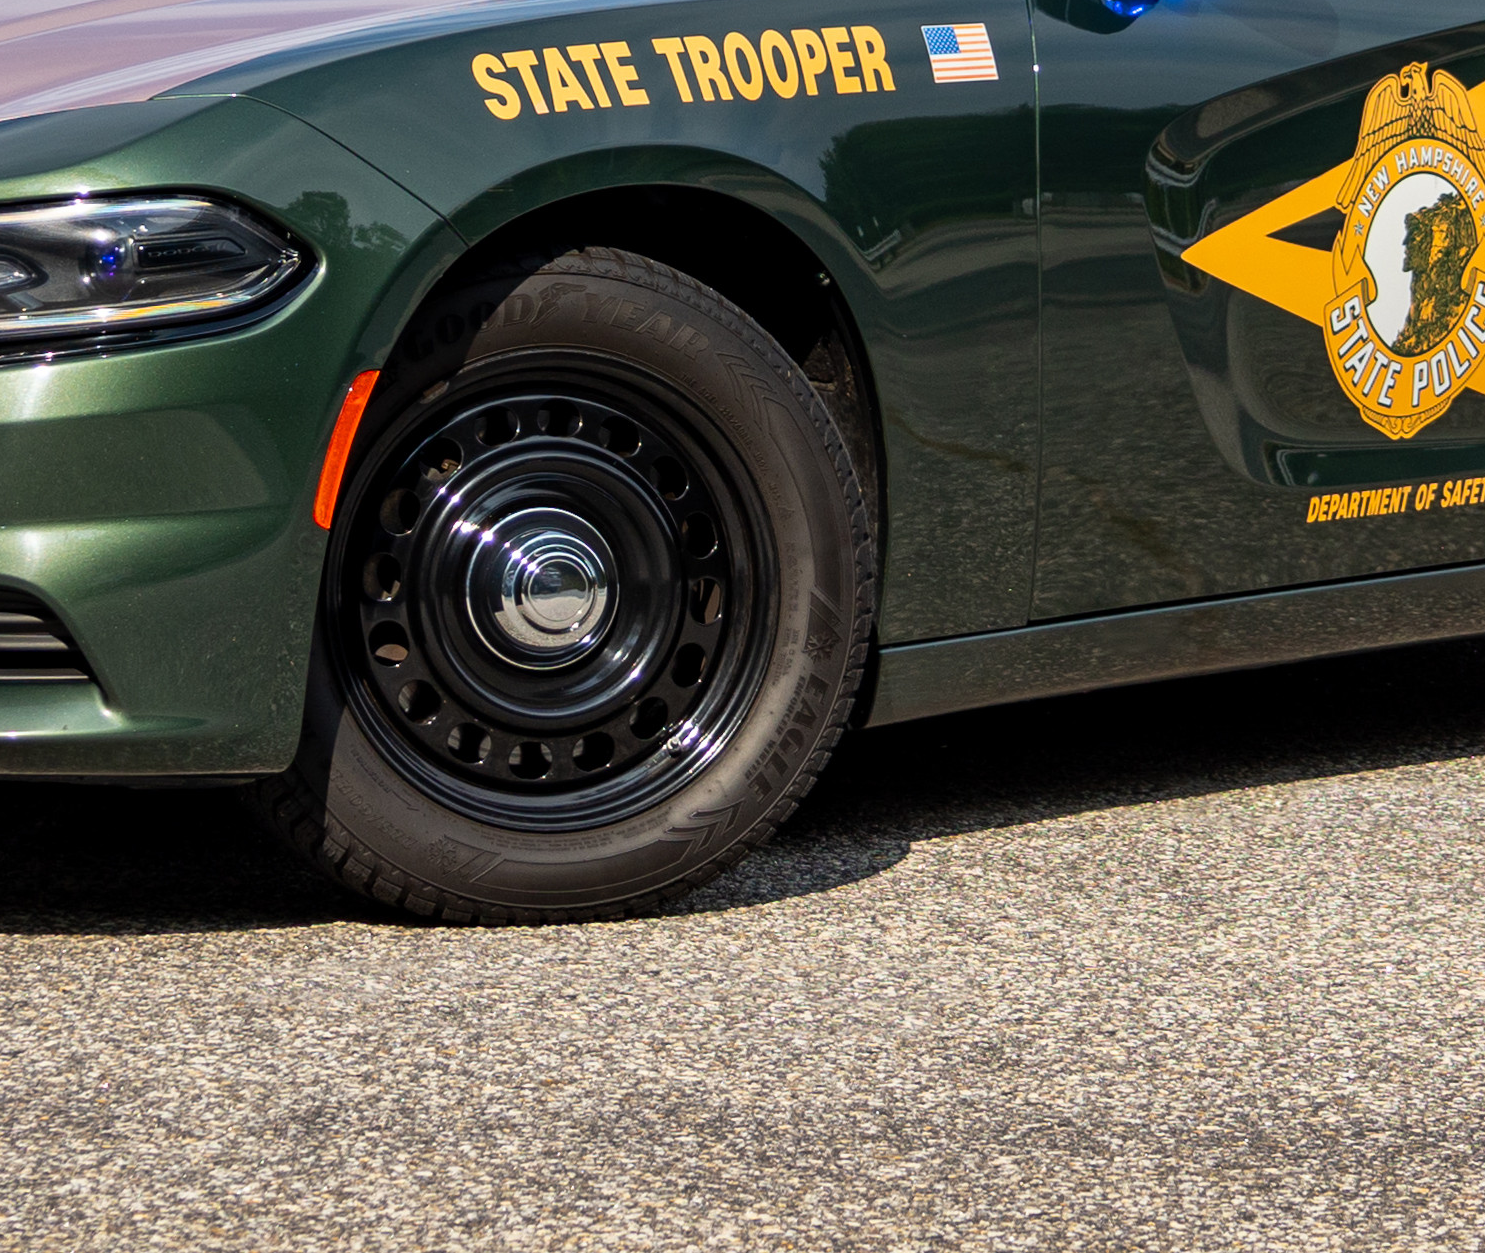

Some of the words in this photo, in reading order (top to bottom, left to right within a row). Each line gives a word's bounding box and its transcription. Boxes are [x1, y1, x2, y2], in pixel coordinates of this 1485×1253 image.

[471, 40, 650, 120] STATE
[652, 25, 896, 103] TROOPER
[1357, 166, 1390, 218] NEW
[1394, 146, 1485, 210] HAMPSHIRE
[1330, 295, 1403, 408] STATE
[1306, 485, 1412, 523] DEPARTMENT
[1415, 482, 1438, 511] OF
